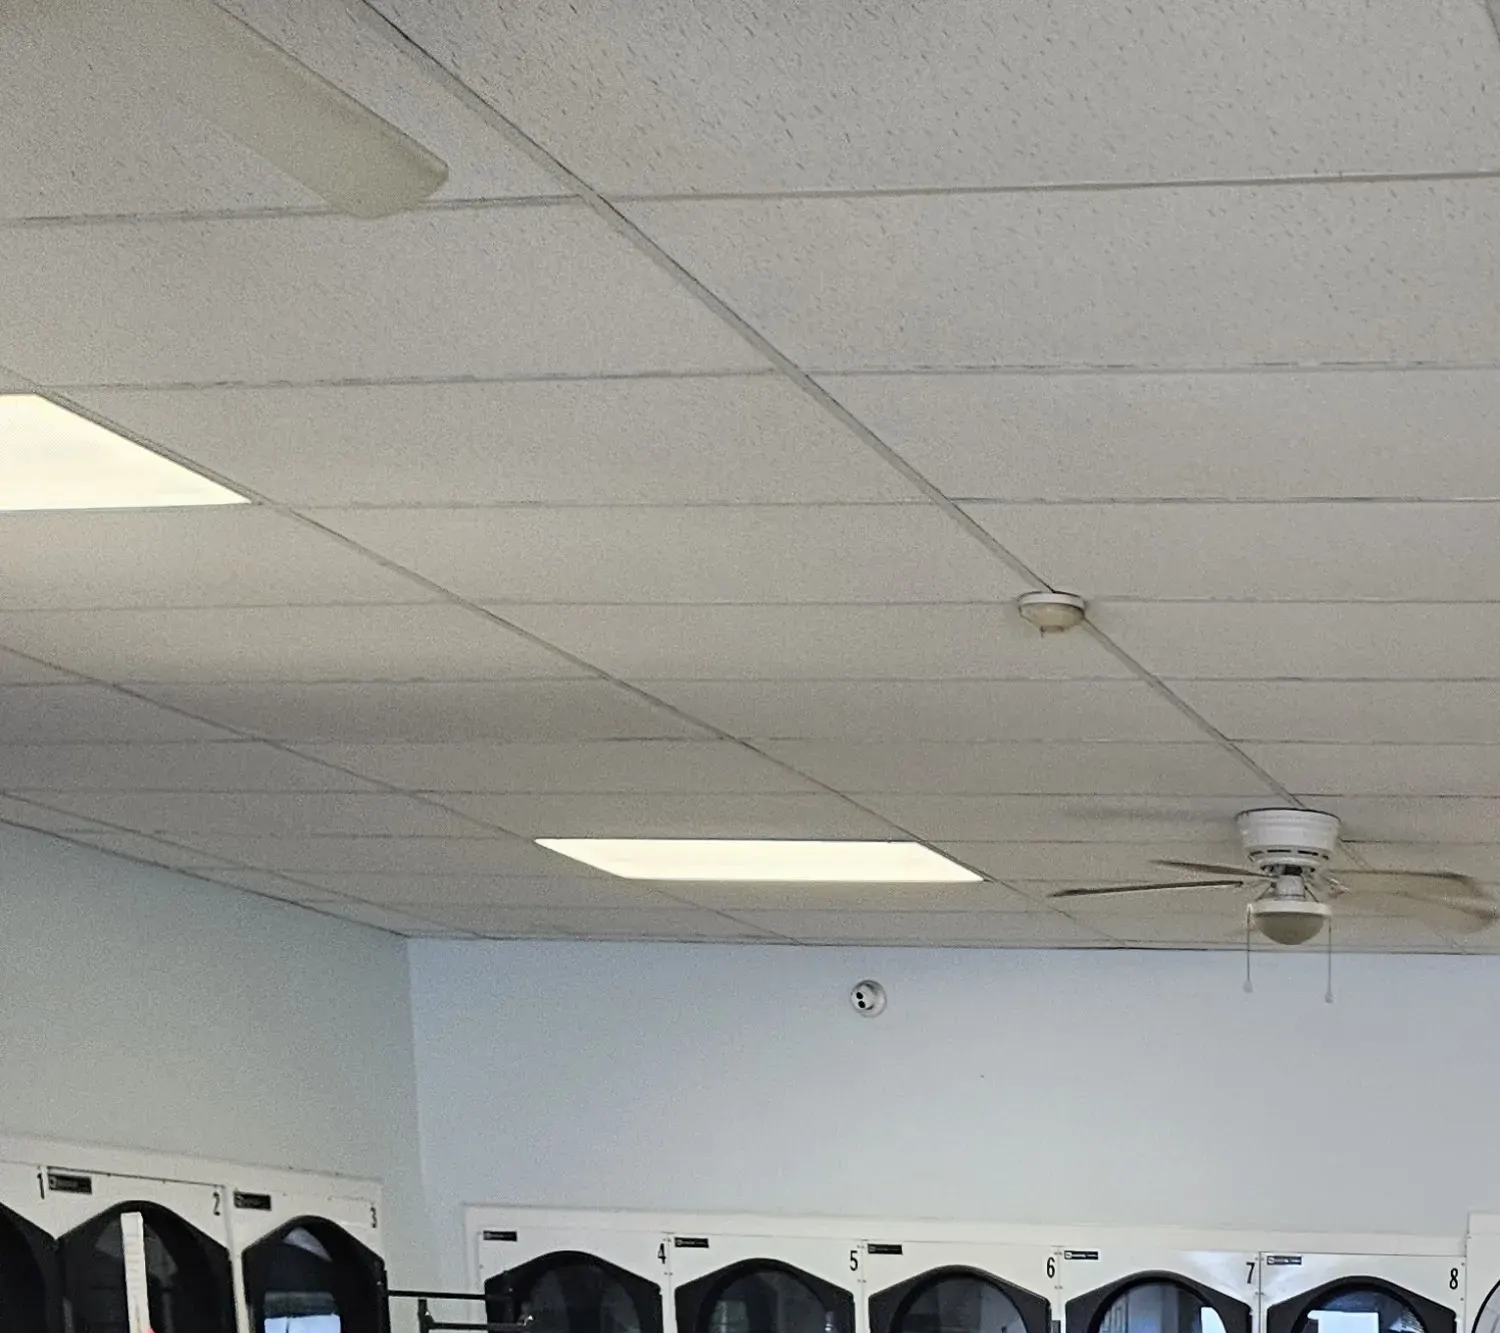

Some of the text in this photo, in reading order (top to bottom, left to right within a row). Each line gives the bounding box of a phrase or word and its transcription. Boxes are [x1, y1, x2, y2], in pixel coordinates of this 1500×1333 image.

[212, 1191, 221, 1217] 2
[657, 1243, 667, 1265] 4
[849, 1249, 859, 1272] 5
[1046, 1256, 1056, 1279] 6
[1246, 1261, 1256, 1285] 7
[1449, 1267, 1459, 1291] 8
